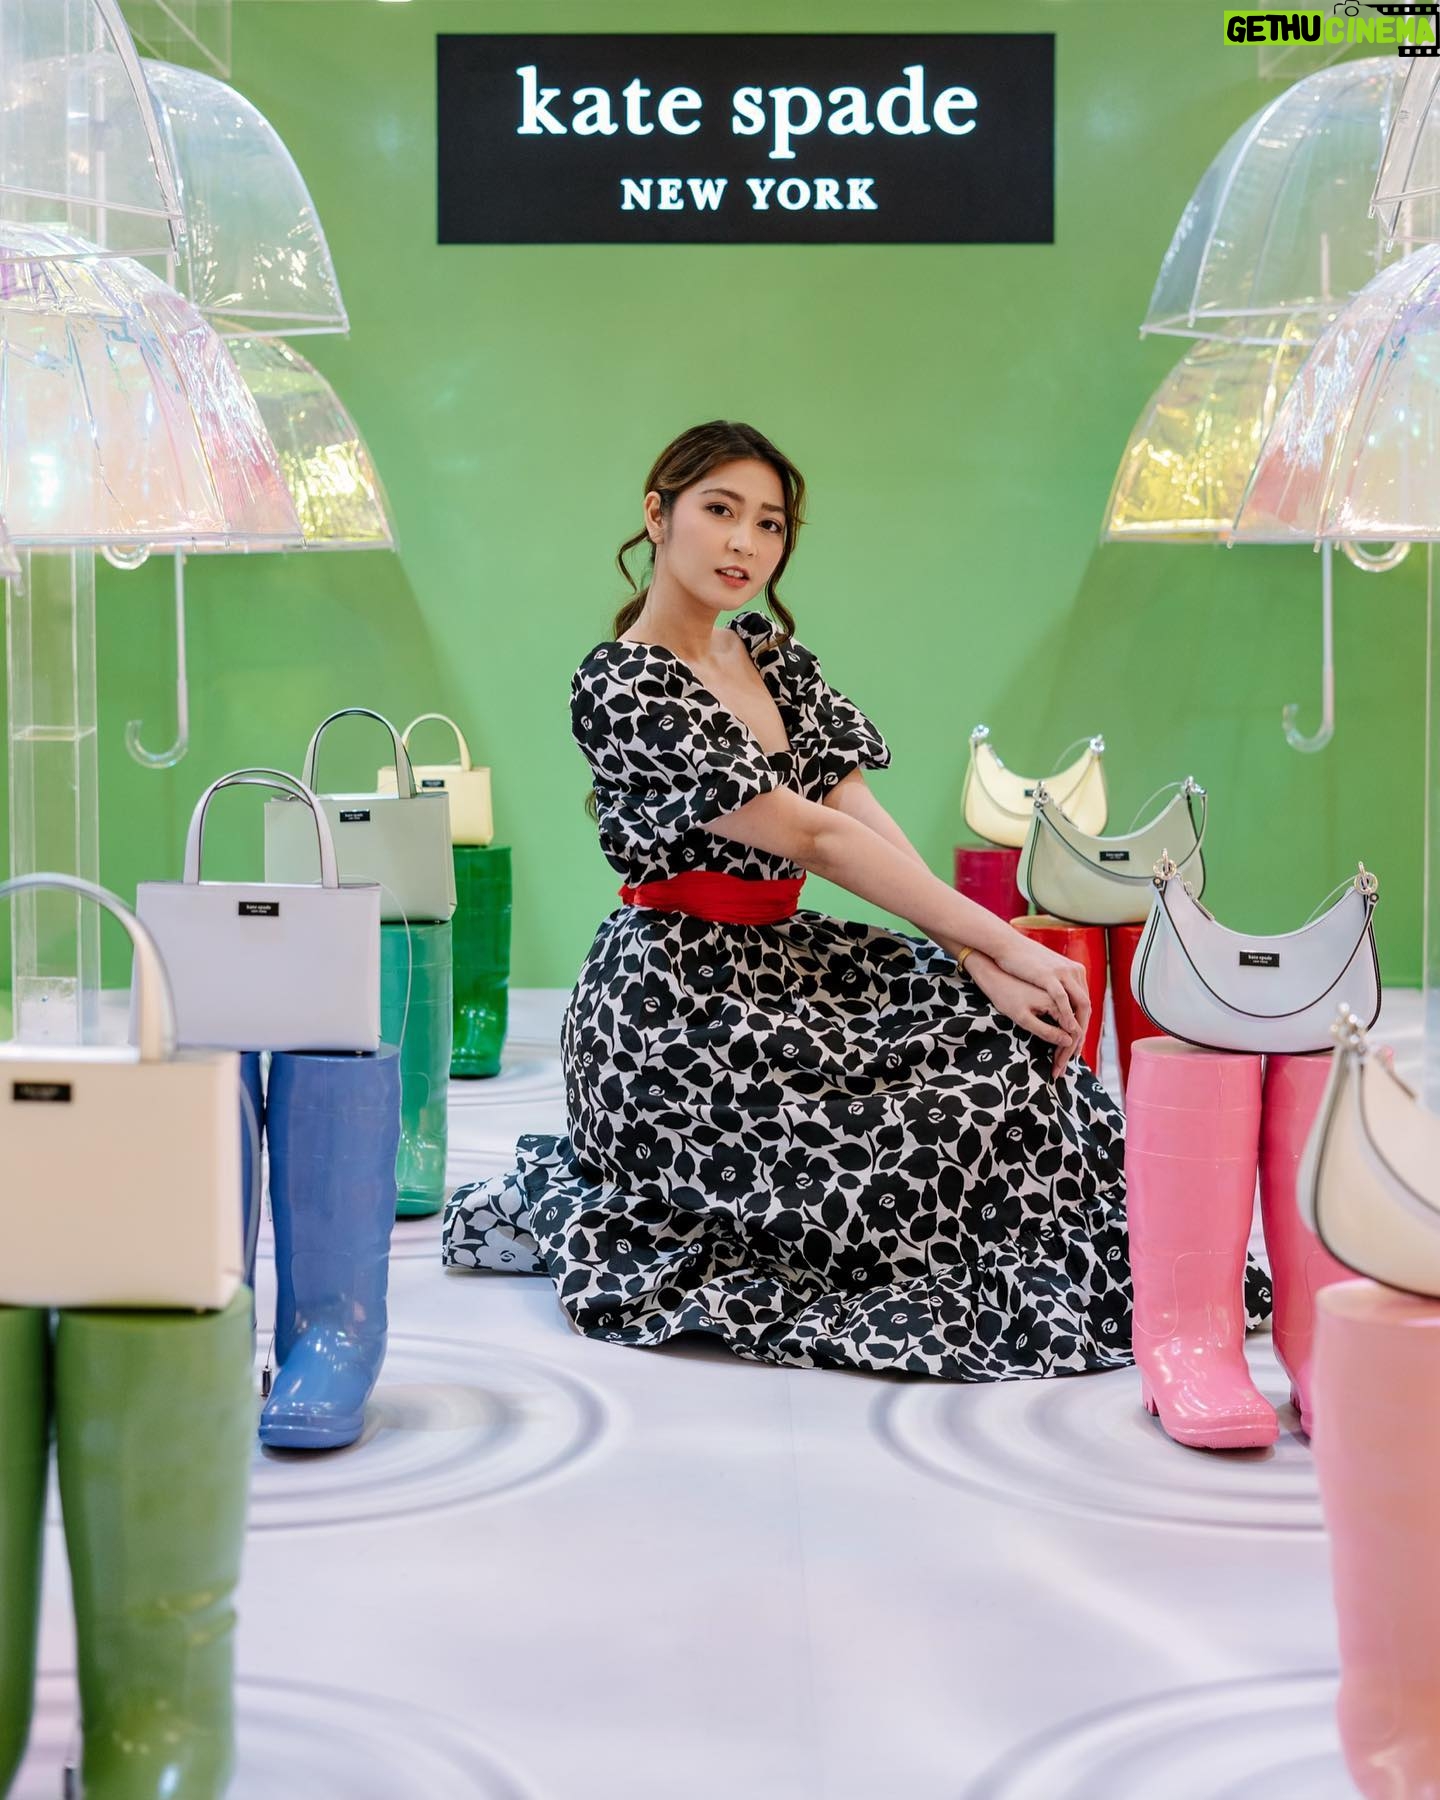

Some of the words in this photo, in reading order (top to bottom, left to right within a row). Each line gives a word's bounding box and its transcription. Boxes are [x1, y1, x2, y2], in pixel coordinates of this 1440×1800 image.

[515, 64, 703, 136] kate
[731, 64, 978, 160] spade
[620, 178, 728, 211] NEW
[745, 178, 879, 211] YORK
